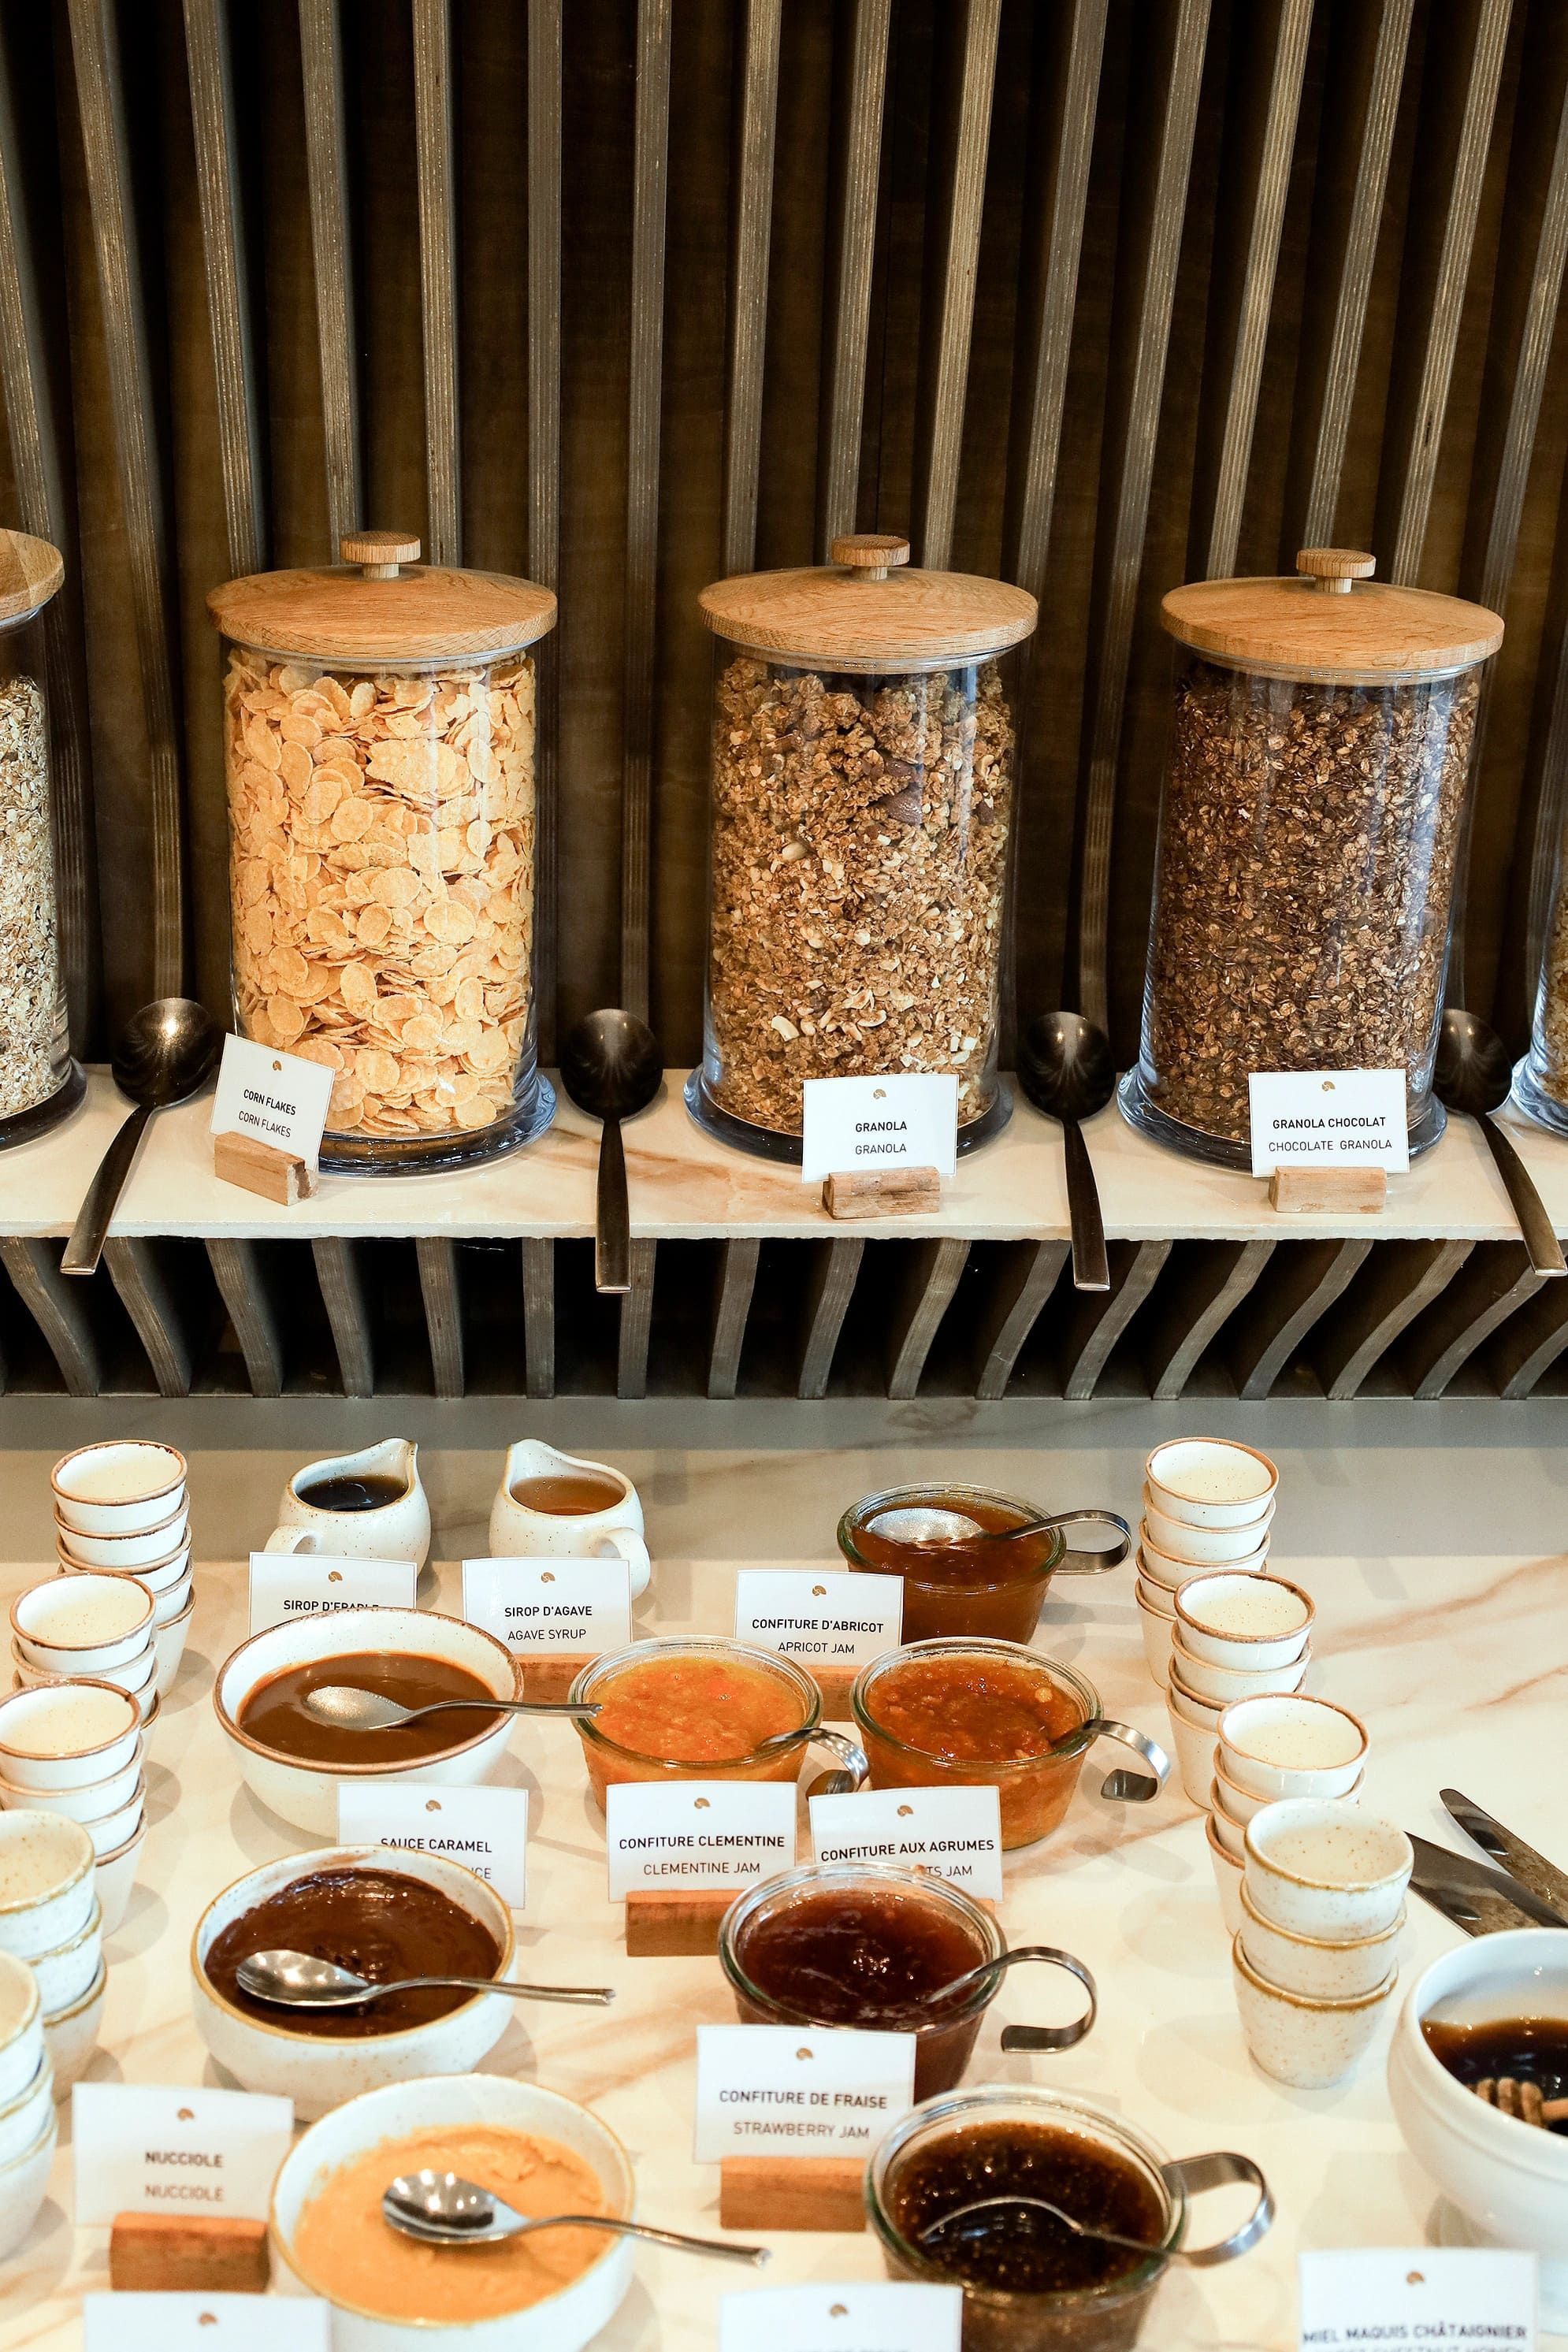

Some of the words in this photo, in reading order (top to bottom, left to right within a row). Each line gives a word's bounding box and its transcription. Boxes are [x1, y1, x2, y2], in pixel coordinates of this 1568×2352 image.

[243, 1089, 265, 1105] CORN
[266, 1098, 296, 1116] FLAKES
[239, 1110, 260, 1127] CORN
[261, 1120, 292, 1138] FLAKES
[855, 1121, 908, 1132] GRANOLA
[1273, 1118, 1325, 1129] GRANOLA
[1328, 1117, 1386, 1128] CHOCOLAT
[855, 1143, 907, 1154] GRANOLA
[1269, 1140, 1334, 1152] CHOCOLATE
[1339, 1139, 1392, 1150] GRANOLA
[284, 1600, 319, 1611] SIROP
[504, 1607, 540, 1617] SIROP
[543, 1606, 593, 1616] D'AGAVE
[752, 1618, 819, 1629] CONFITURE
[822, 1620, 884, 1633] D'ABRICOT
[507, 1629, 545, 1640] AGAVE
[548, 1629, 587, 1639] SYRUP
[778, 1641, 827, 1652] APRICOT
[831, 1643, 855, 1654] JAM
[381, 1837, 425, 1849] SAUCE
[429, 1839, 492, 1852] CARAMEL
[619, 1836, 694, 1849] CONFITURE
[698, 1835, 786, 1848] CLEMENTINE
[821, 1844, 896, 1861] CONFITURE
[899, 1842, 926, 1854] AUX
[929, 1840, 994, 1852] AGRUMES
[644, 1862, 730, 1875] CLEMENTINE
[734, 1863, 760, 1874] JAM
[946, 1865, 972, 1877] JAM
[719, 2090, 805, 2105] CONFITURE
[810, 2093, 830, 2106] DE
[834, 2094, 888, 2109] FRAISE
[734, 2121, 835, 2138] STRAWBERRY
[839, 2126, 870, 2139] JAM
[145, 2151, 224, 2168] NUCCIOLE
[145, 2185, 225, 2202] NUCCIOLE
[1303, 2329, 1339, 2343] MIEL
